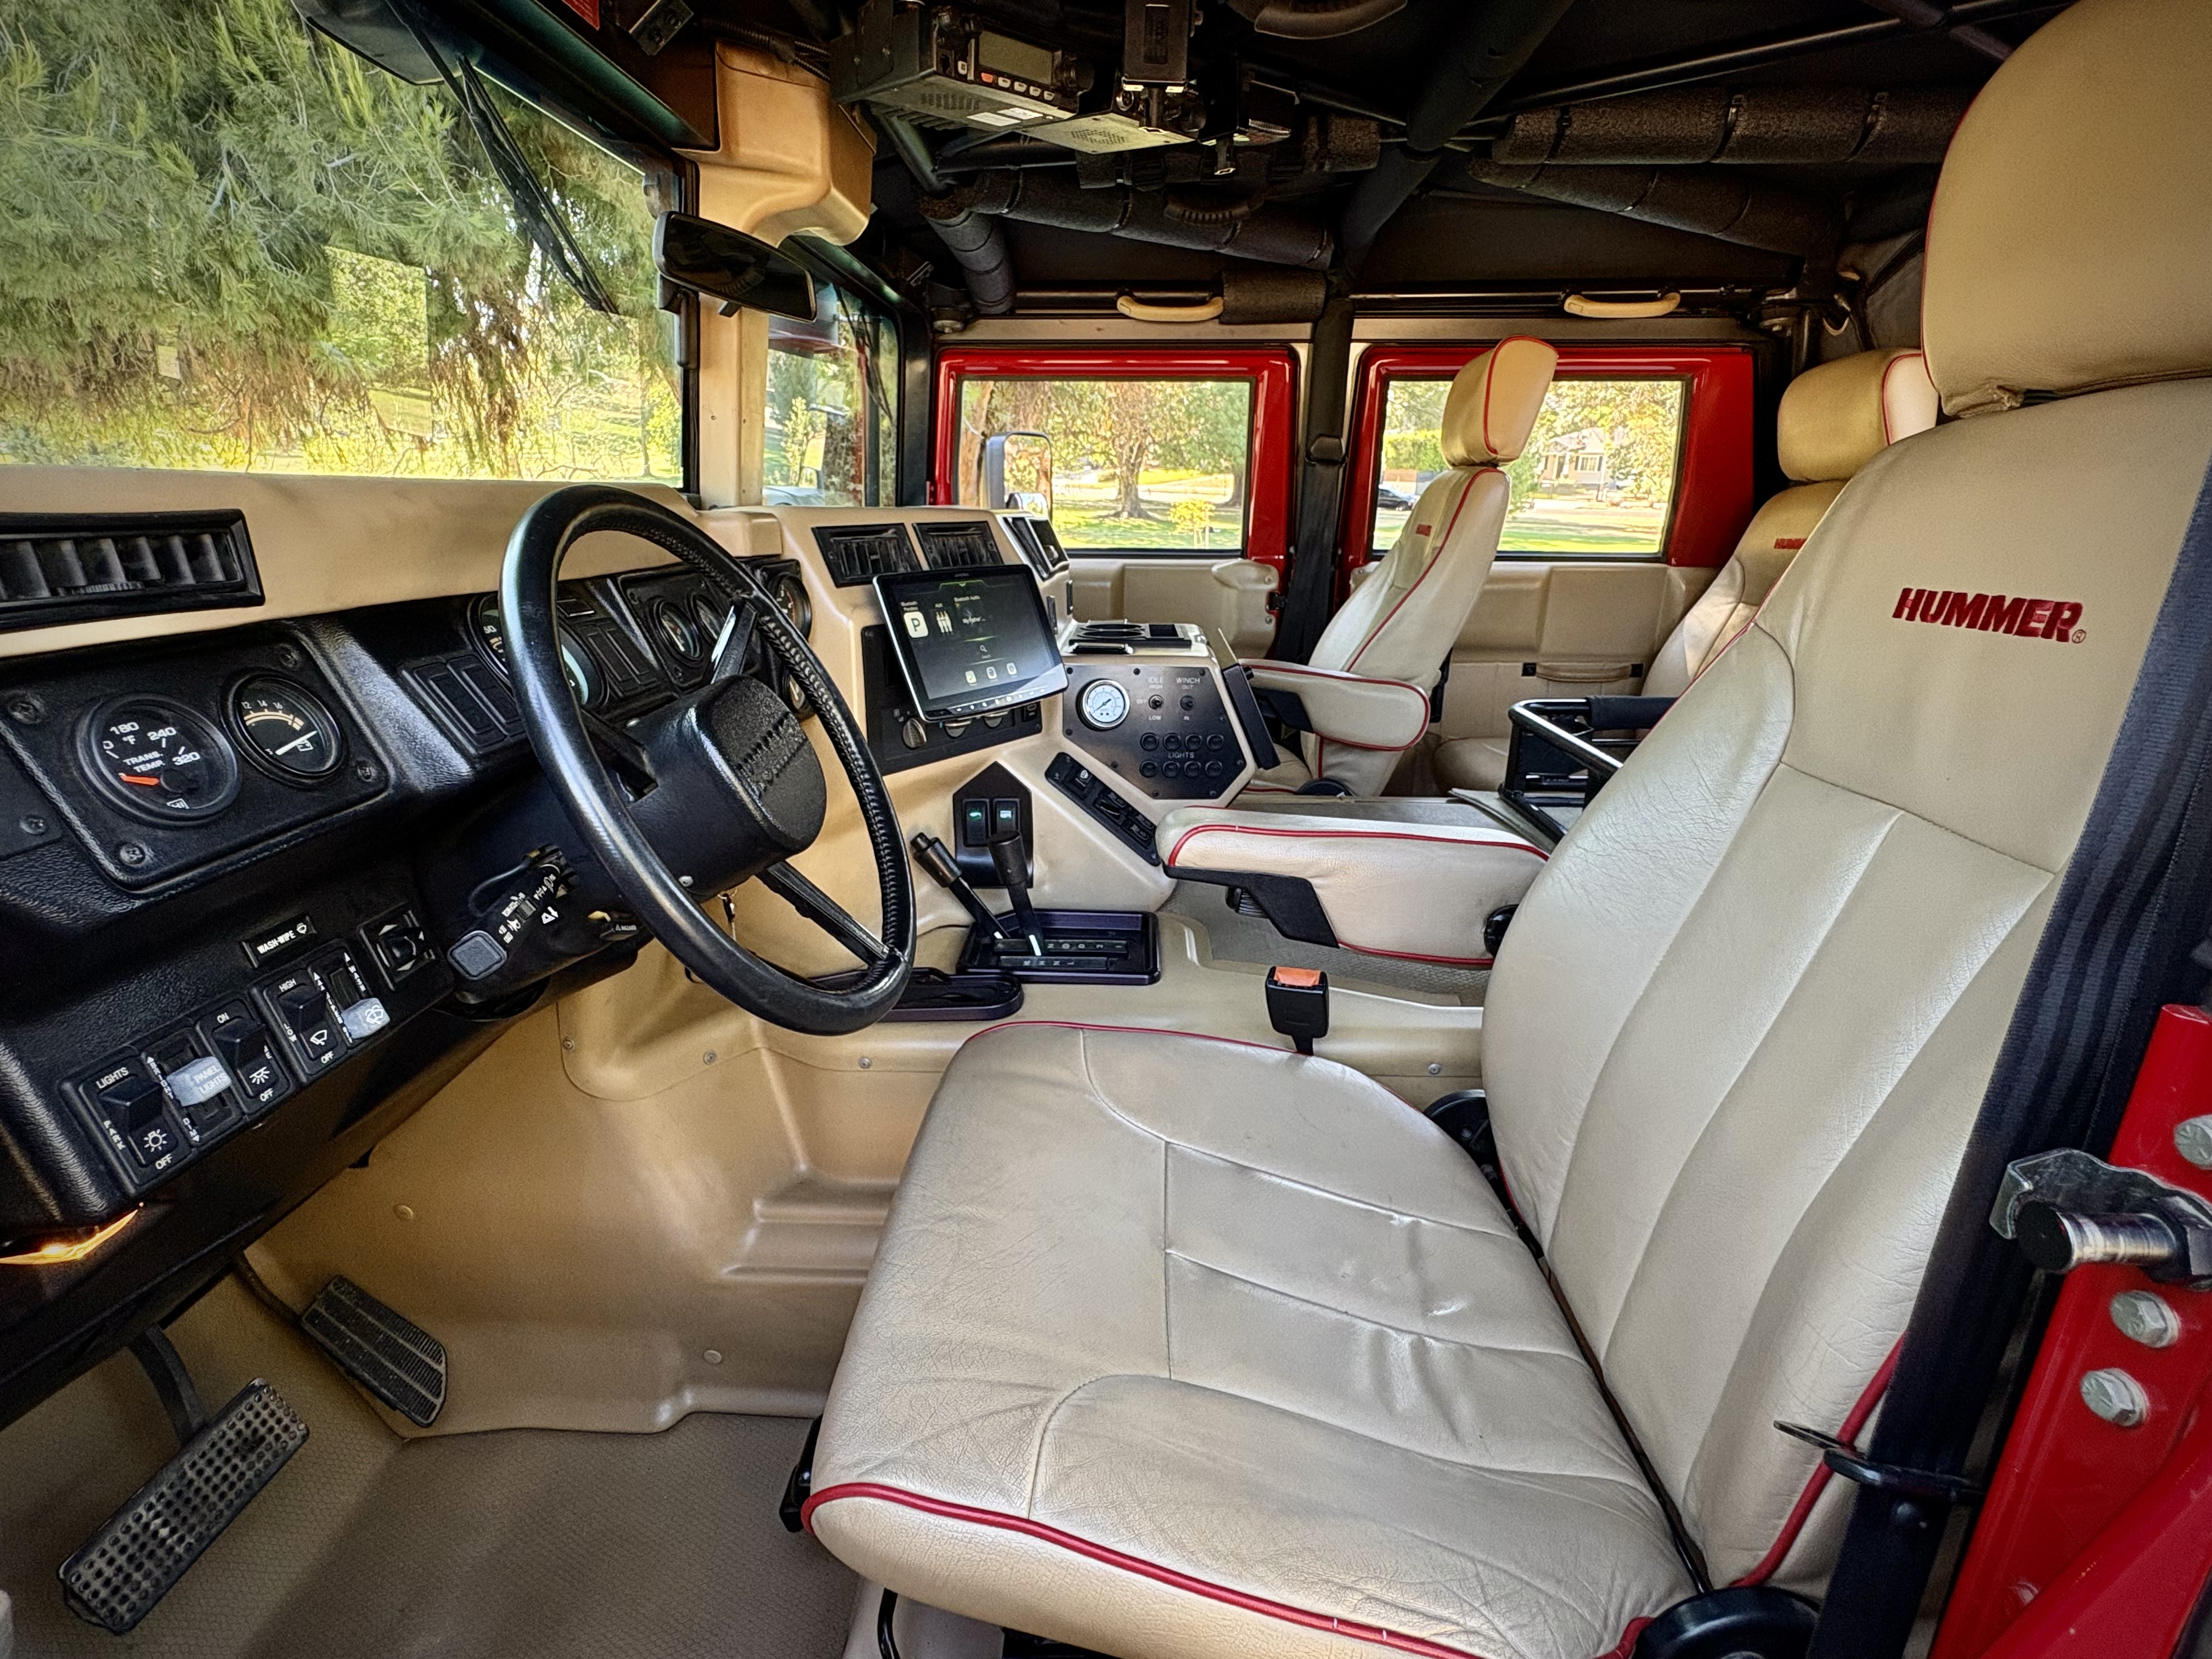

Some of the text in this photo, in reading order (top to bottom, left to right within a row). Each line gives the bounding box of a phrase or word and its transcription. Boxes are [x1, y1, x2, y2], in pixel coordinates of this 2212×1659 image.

[110, 722, 139, 735] 180
[147, 727, 177, 741] 240
[123, 751, 164, 766] TRANS.
[133, 760, 166, 772] TEMP.
[172, 752, 201, 765] 320
[257, 930, 296, 954] WASH-WIPE
[279, 978, 297, 992] HIGH
[217, 1012, 229, 1024] ON
[284, 1023, 297, 1042] LOW
[321, 1051, 334, 1064] OFF
[95, 1066, 129, 1090] LIGHTS
[150, 1062, 173, 1099] BRIGHT
[194, 1064, 221, 1084] PANEL
[198, 1073, 228, 1094] LIGHTS
[259, 1088, 273, 1102] OFF
[104, 1120, 126, 1150] PARK
[183, 1117, 198, 1137] DIM
[155, 1153, 173, 1170] OFF
